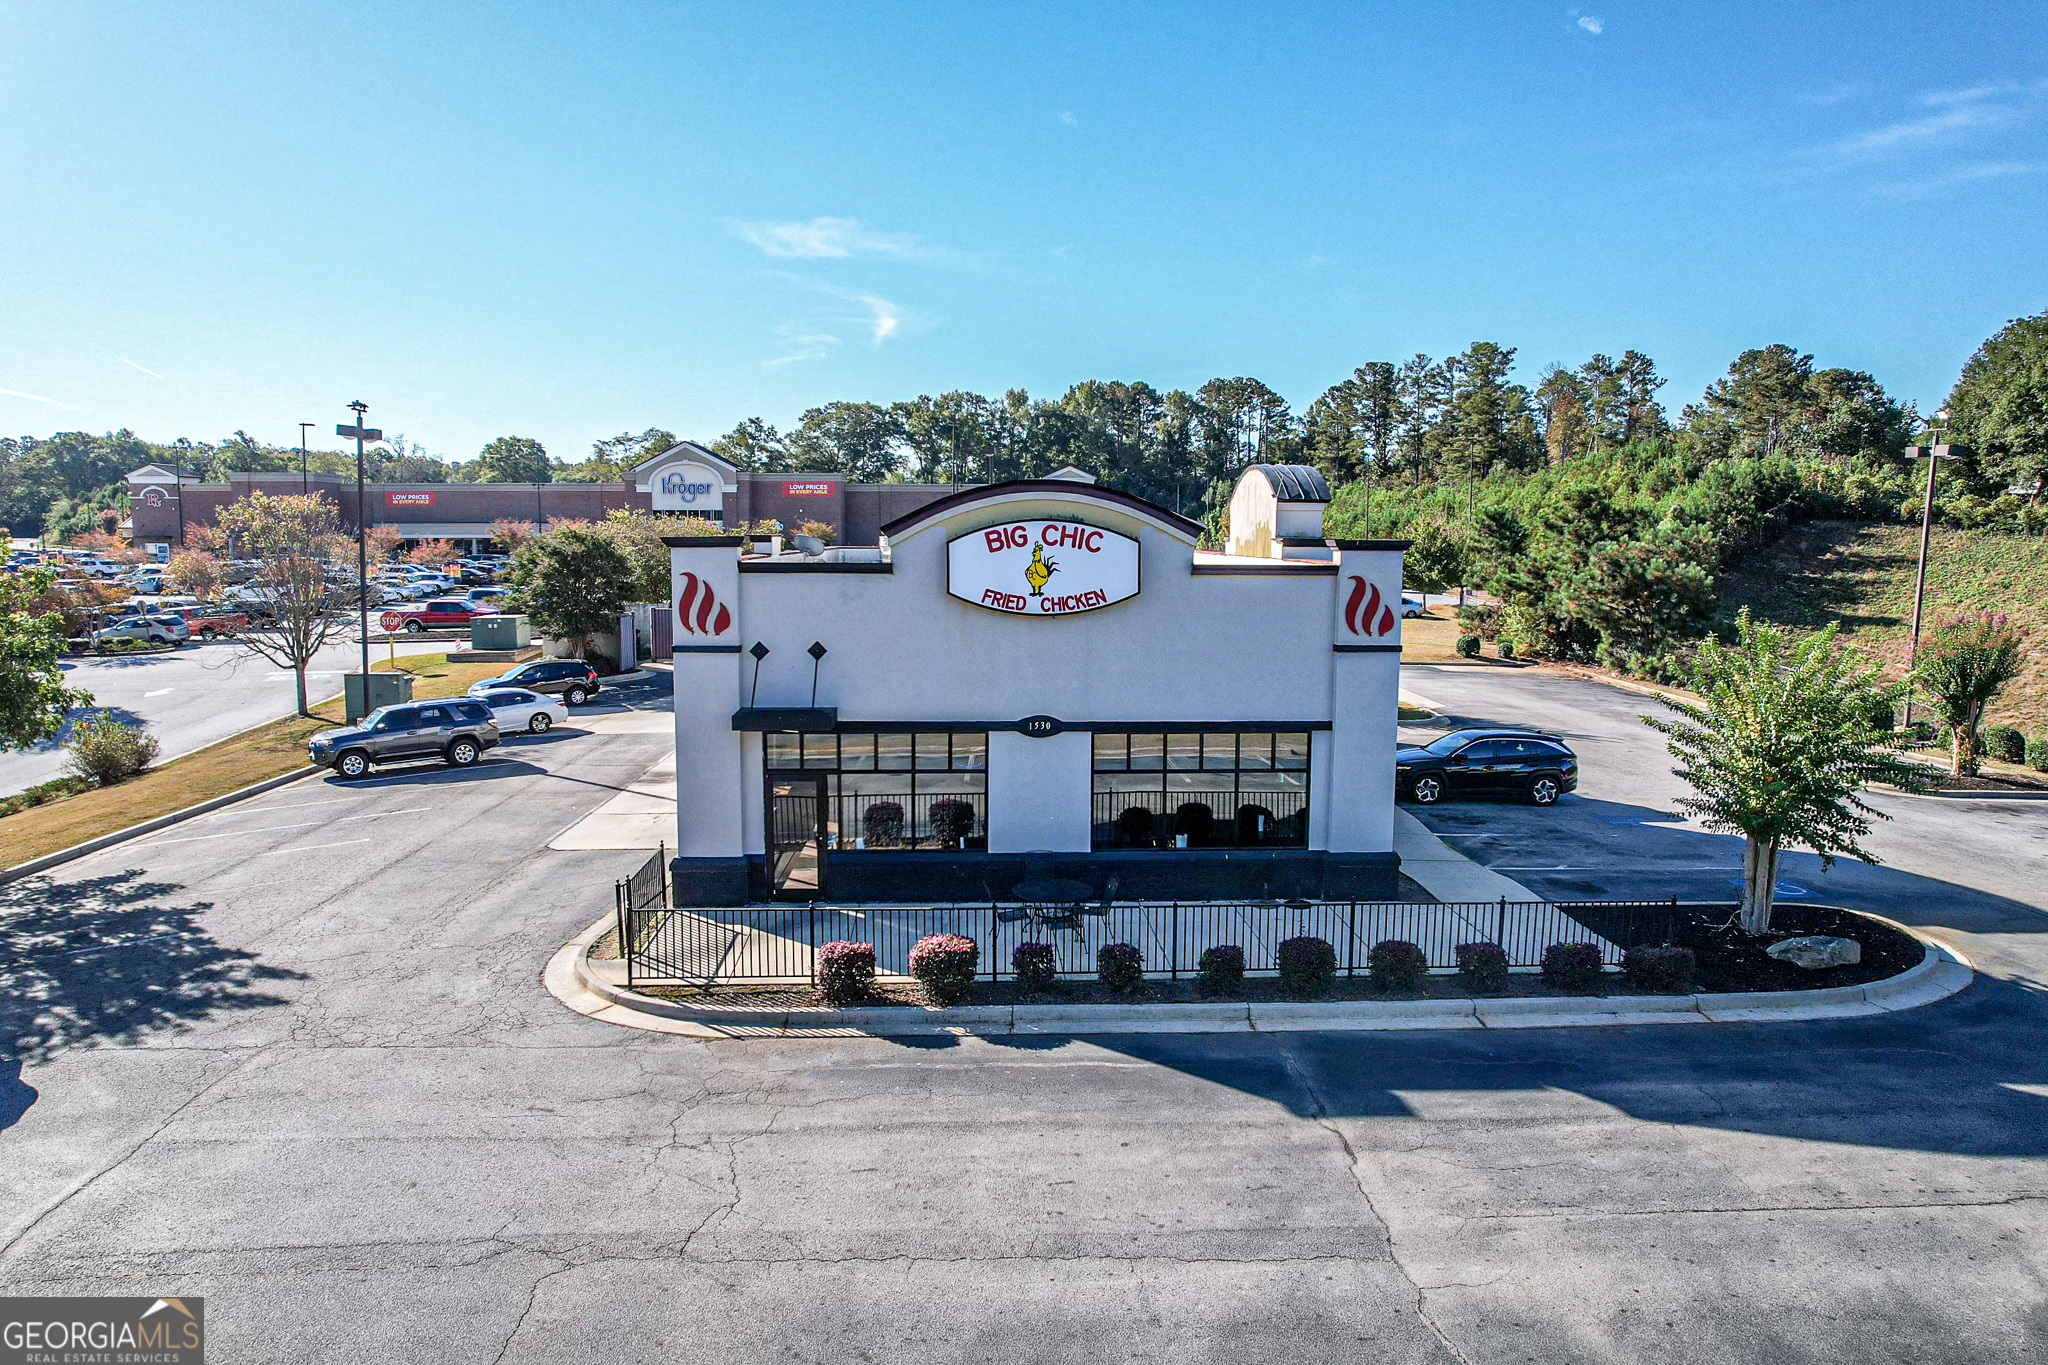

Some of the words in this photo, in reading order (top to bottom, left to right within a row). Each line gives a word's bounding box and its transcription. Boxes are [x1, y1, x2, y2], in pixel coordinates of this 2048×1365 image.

[662, 472, 713, 503] Kroger
[984, 525, 1028, 553] BIG
[1041, 524, 1104, 553] CHIC
[981, 588, 1027, 611] FRIED
[1040, 588, 1108, 612] CHICKEN
[381, 617, 399, 626] STOP
[1029, 721, 1051, 730] 1530
